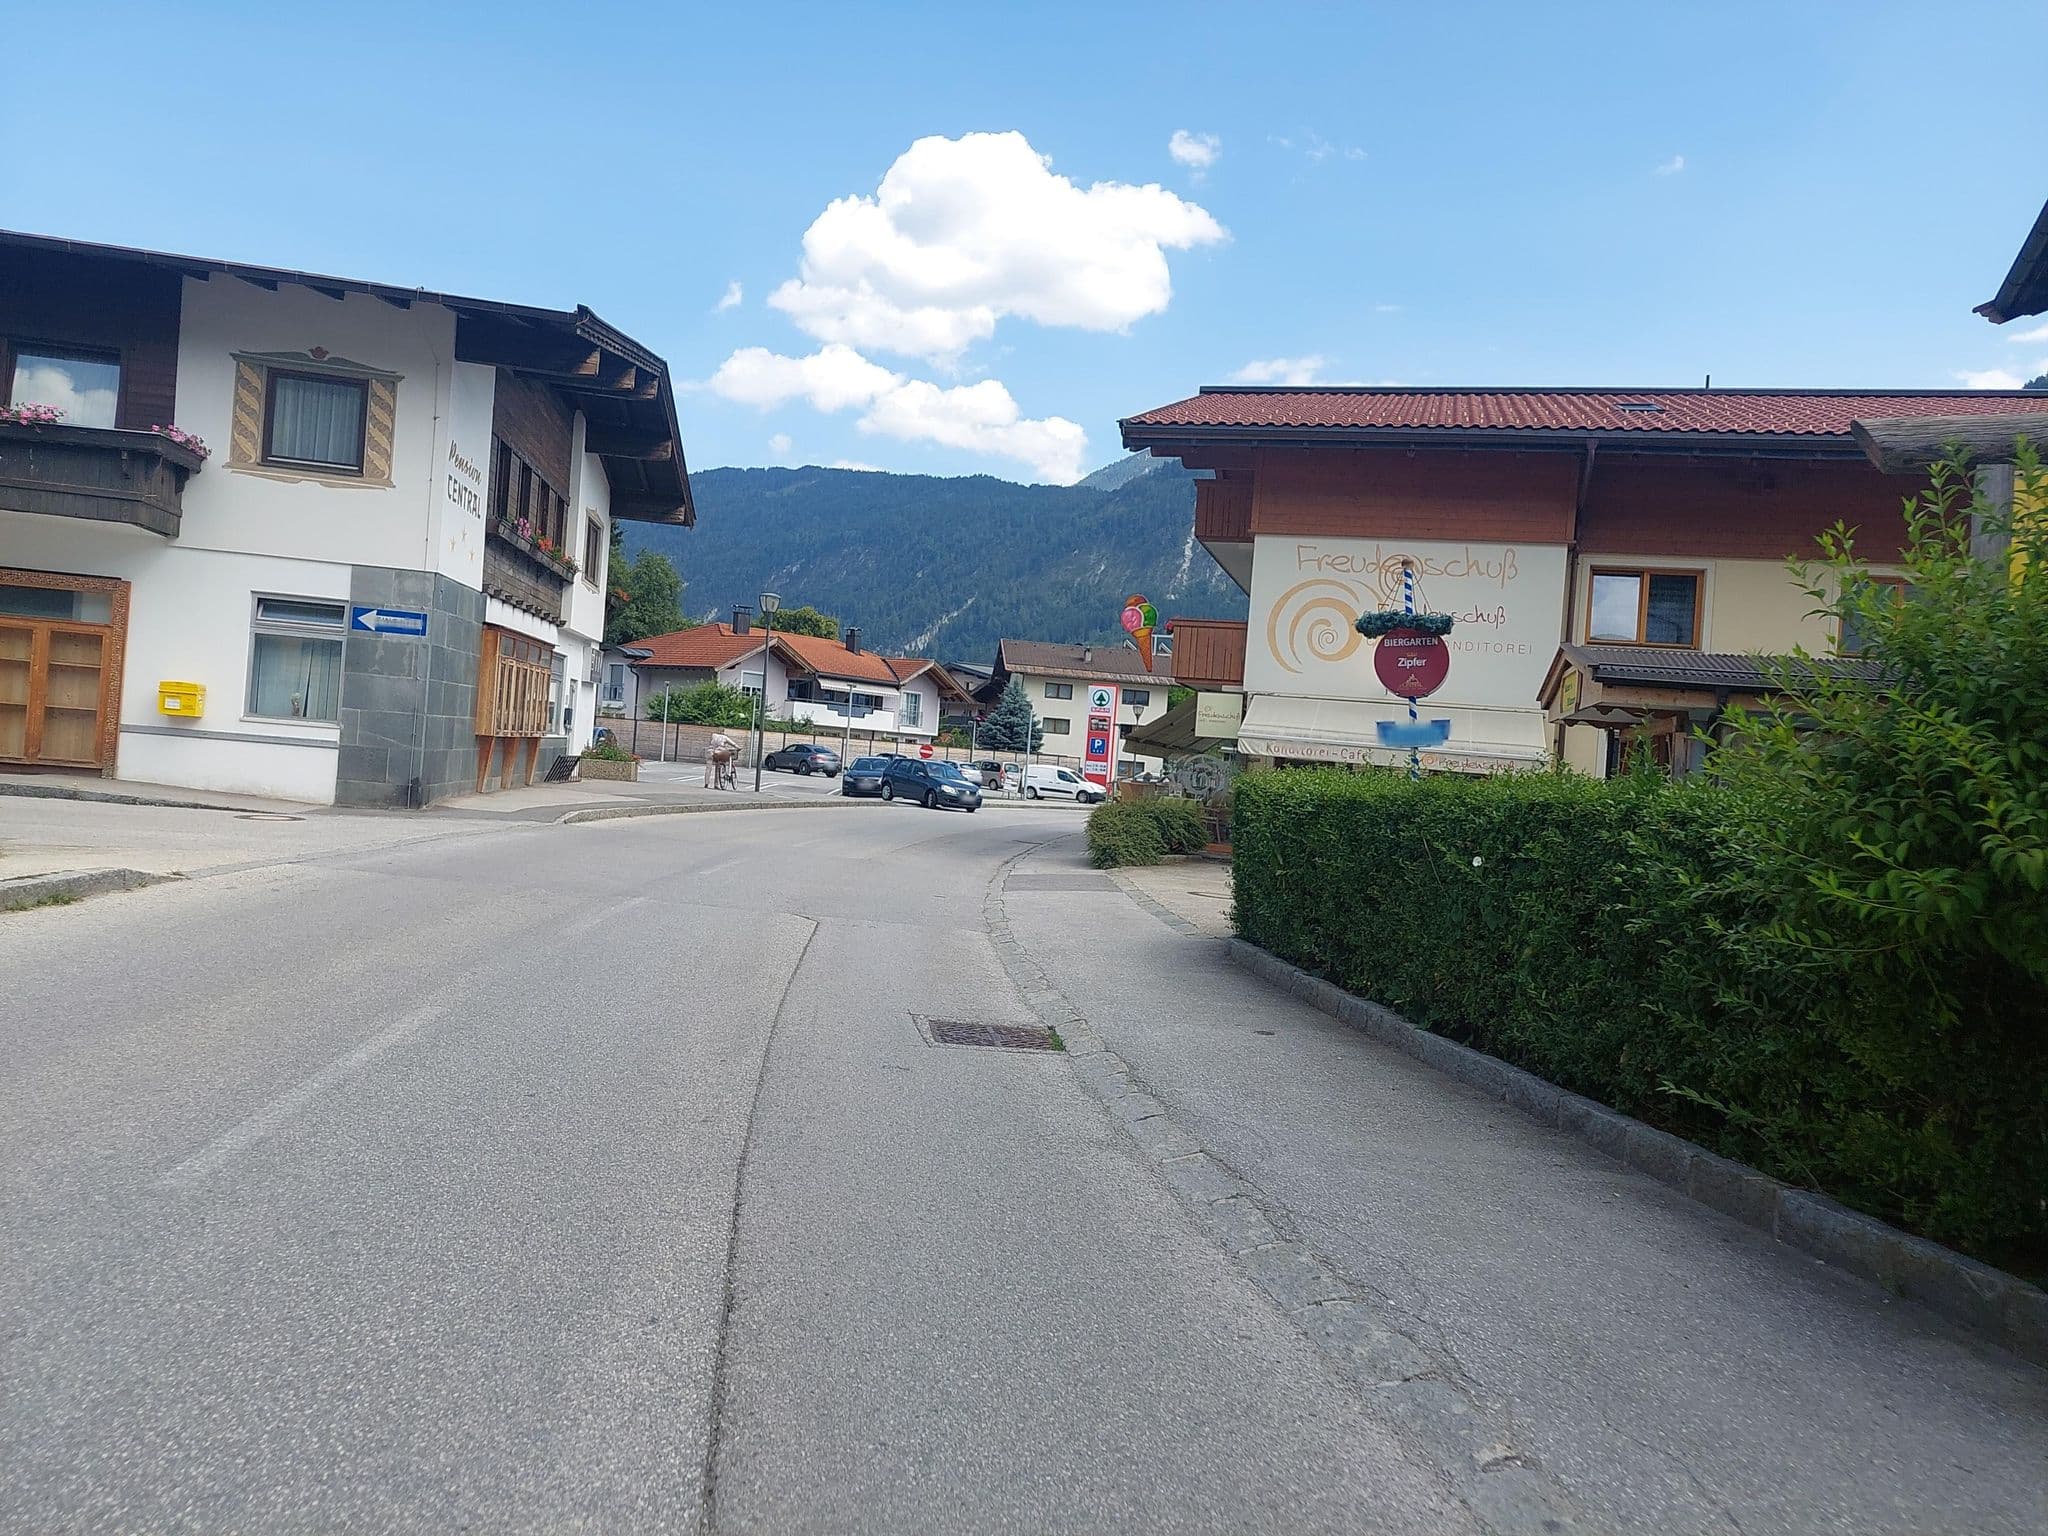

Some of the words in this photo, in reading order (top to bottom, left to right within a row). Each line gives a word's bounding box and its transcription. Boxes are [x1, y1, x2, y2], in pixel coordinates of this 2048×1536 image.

[448, 439, 482, 486] Pension
[447, 473, 481, 520] CENTRAL
[1384, 637, 1438, 647] BIERGARTEN
[1444, 639, 1533, 656] NDITOREI
[1397, 657, 1427, 669] Zipfer
[1094, 739, 1103, 750] P
